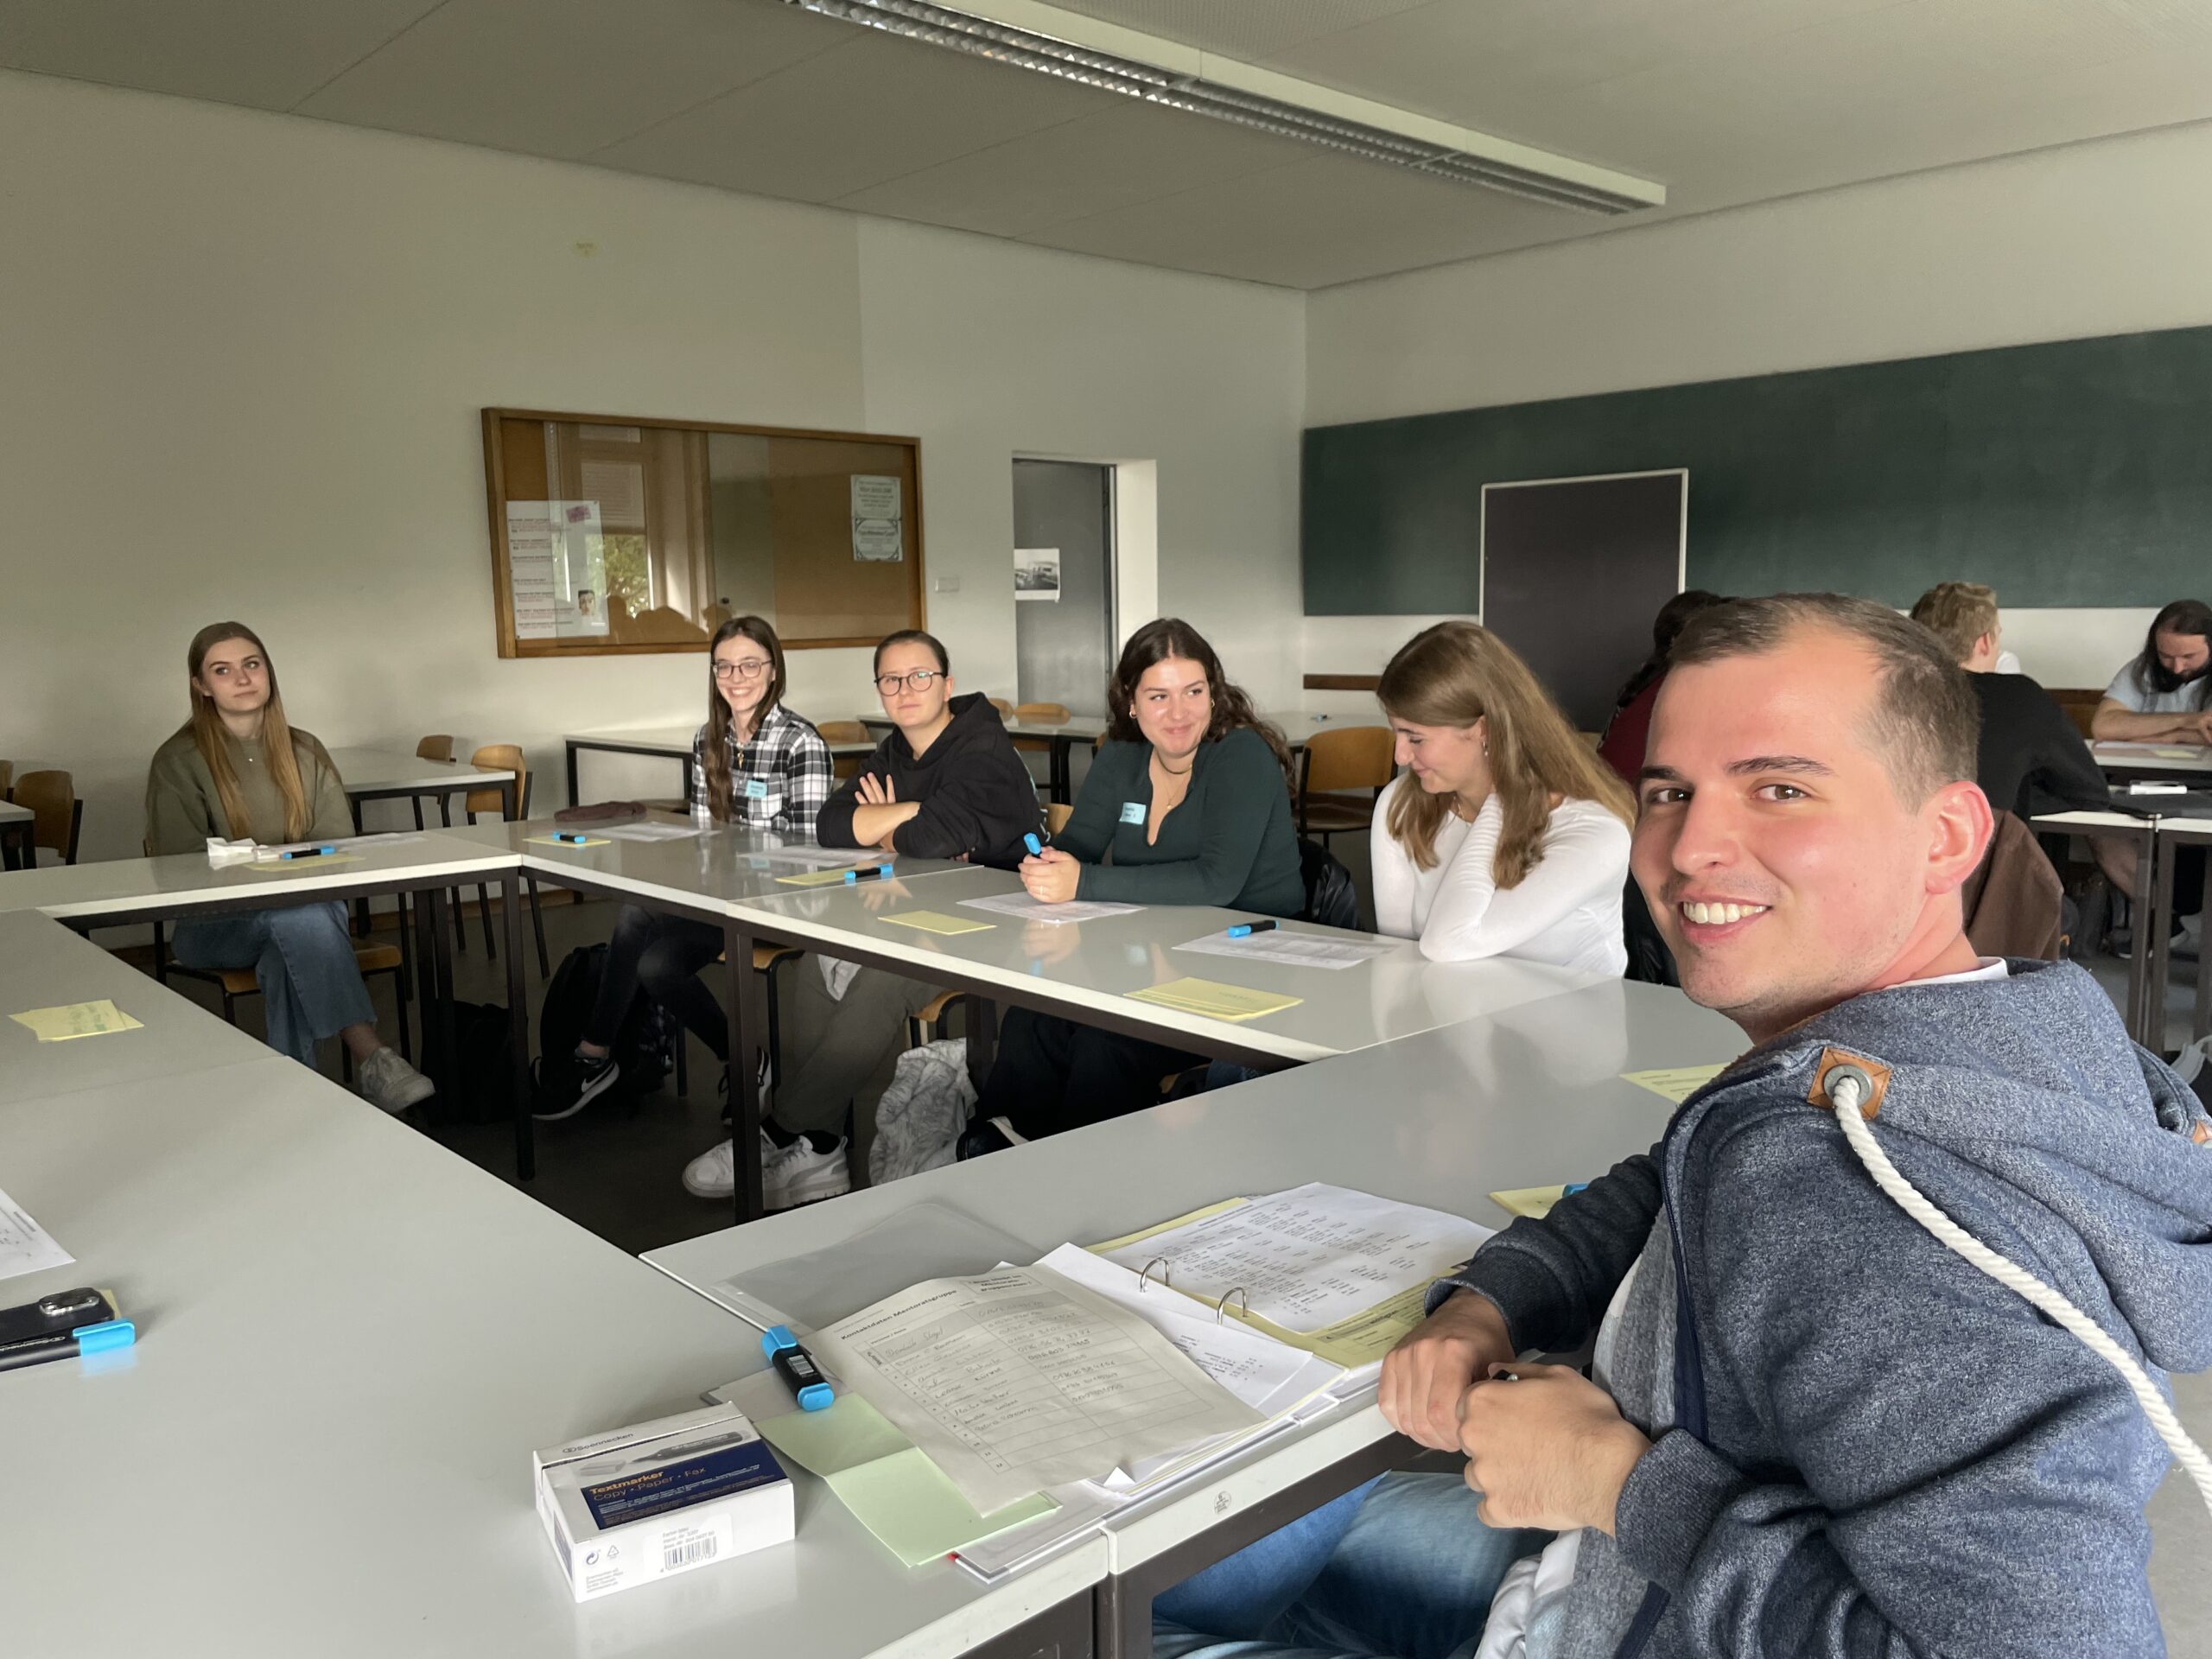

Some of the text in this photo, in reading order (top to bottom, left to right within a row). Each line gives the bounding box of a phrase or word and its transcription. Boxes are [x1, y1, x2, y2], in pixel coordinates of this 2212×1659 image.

[576, 1433, 634, 1452] Soennecken
[589, 1471, 664, 1495] Textmarker
[594, 1467, 706, 1502] Copy Paper Fax
